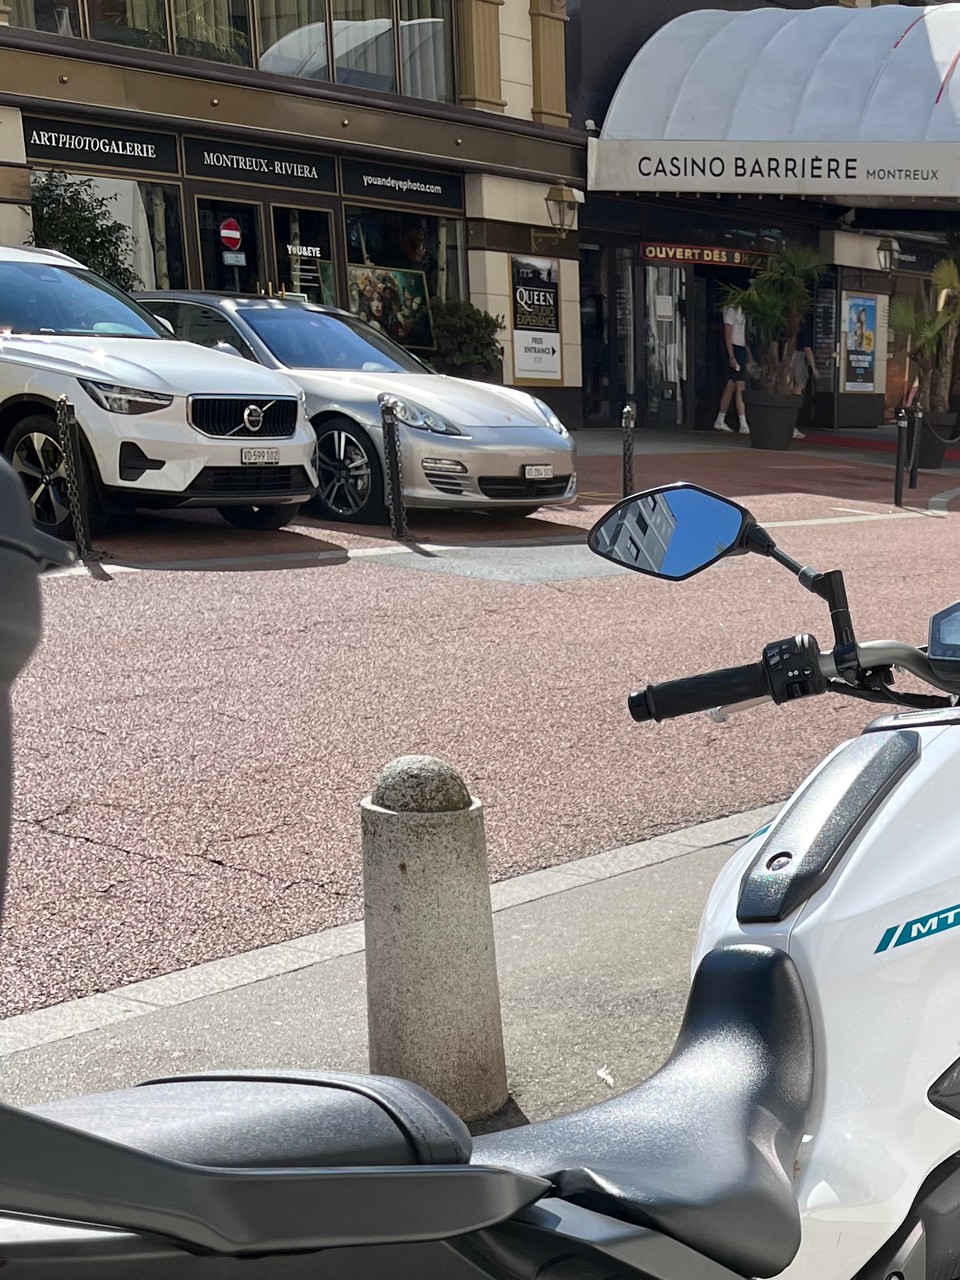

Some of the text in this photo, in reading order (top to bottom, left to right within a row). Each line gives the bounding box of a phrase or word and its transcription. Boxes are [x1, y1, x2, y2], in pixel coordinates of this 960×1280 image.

[31, 130, 156, 158] ARTPHOTOGALERIE
[638, 156, 940, 181] CASINO BARRIÈRE MONTREUX
[362, 175, 442, 194] youandeyephoto.com
[646, 247, 700, 260] OUVERT
[517, 288, 554, 311] QUEEN
[524, 346, 551, 355] ENTRANCE
[531, 337, 543, 345] FREE
